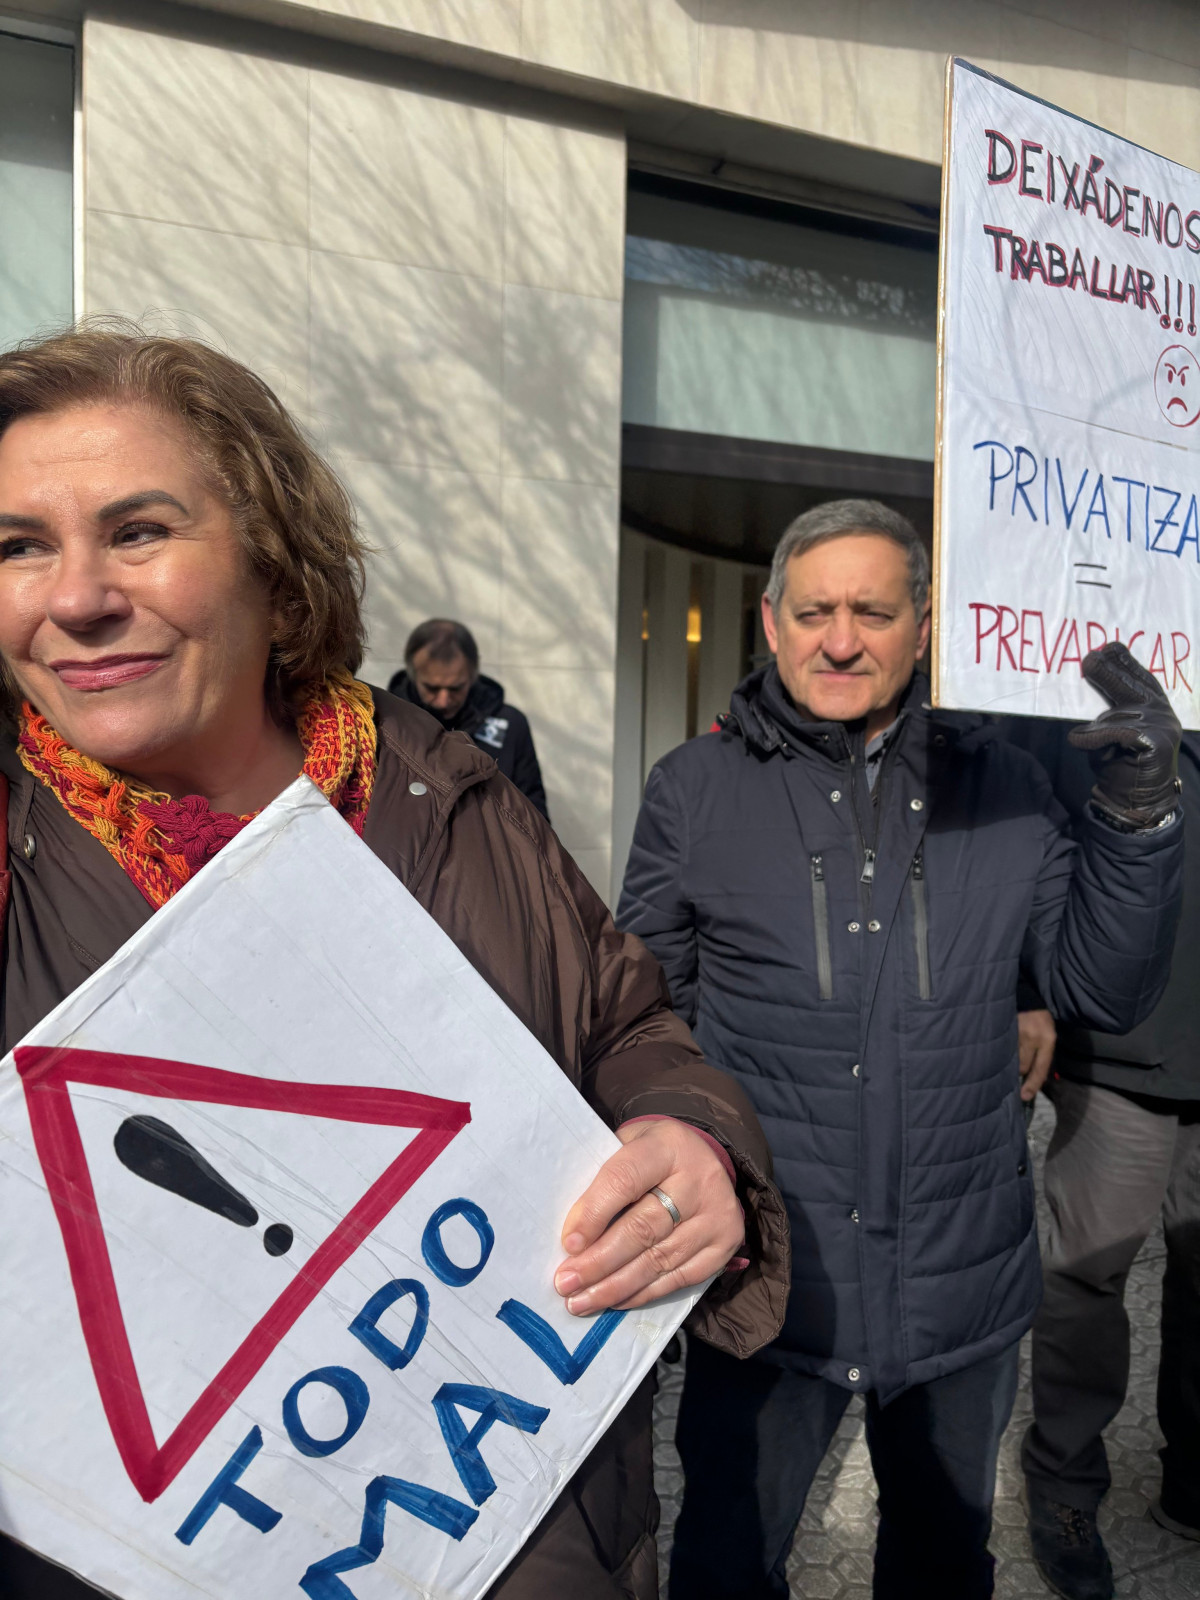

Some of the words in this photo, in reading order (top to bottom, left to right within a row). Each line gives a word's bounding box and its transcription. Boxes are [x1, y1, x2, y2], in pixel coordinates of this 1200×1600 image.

[984, 129, 1200, 255] DEIXÁDENOS
[983, 224, 1197, 336] TRABALLAR!!!
[968, 603, 1192, 693] PREVARAR
[174, 1197, 495, 1546] TODO
[299, 1299, 627, 1600] MAL
